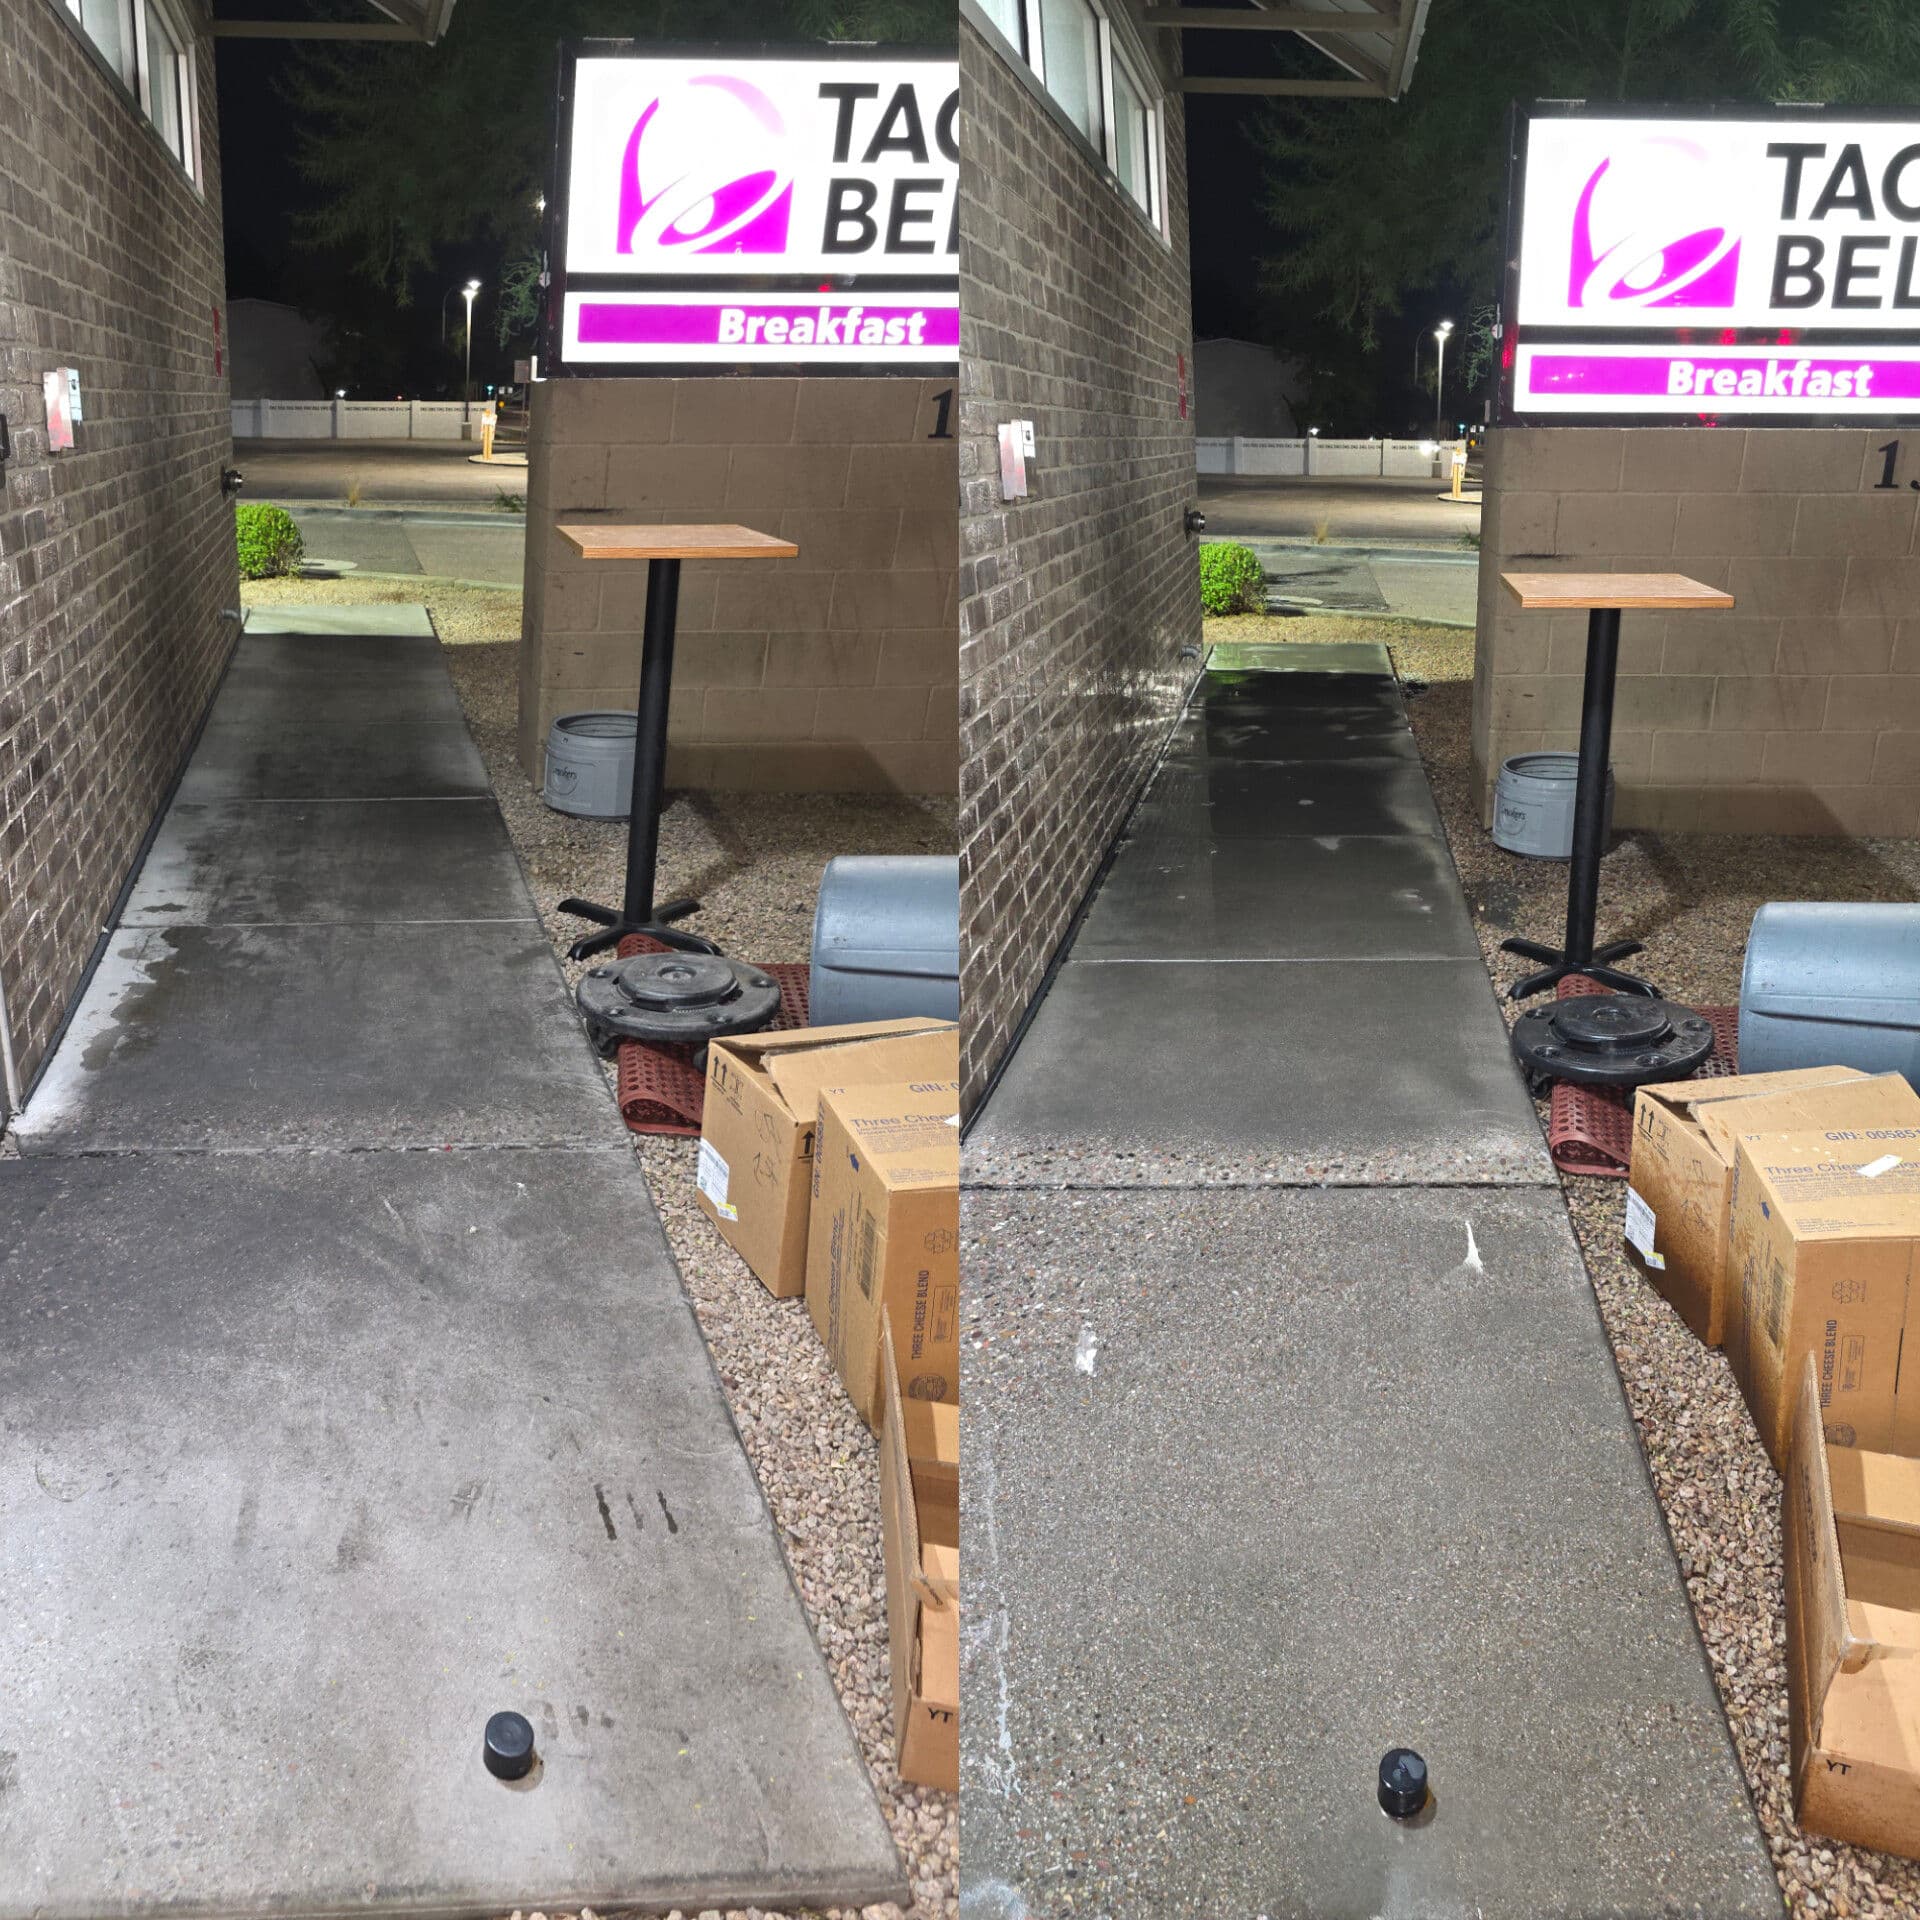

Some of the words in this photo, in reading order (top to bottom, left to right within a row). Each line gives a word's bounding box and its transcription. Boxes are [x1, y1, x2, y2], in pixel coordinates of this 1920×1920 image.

[818, 83, 959, 164] TA
[821, 178, 959, 254] BE
[717, 307, 926, 345] Breakfast
[1667, 359, 1873, 398] Breakfast
[928, 388, 953, 439] 1
[1874, 439, 1920, 490] 1
[849, 1117, 902, 1127] Three
[1764, 1166, 1813, 1175] Three
[917, 1270, 930, 1298] BLEND
[913, 1300, 926, 1332] CHEESE
[911, 1333, 924, 1360] THREE
[1825, 1320, 1837, 1347] BLEND
[1823, 1348, 1835, 1380] CHEESE
[1821, 1382, 1832, 1408] THREE
[927, 1706, 954, 1724] YT
[1825, 1758, 1852, 1777] YT
